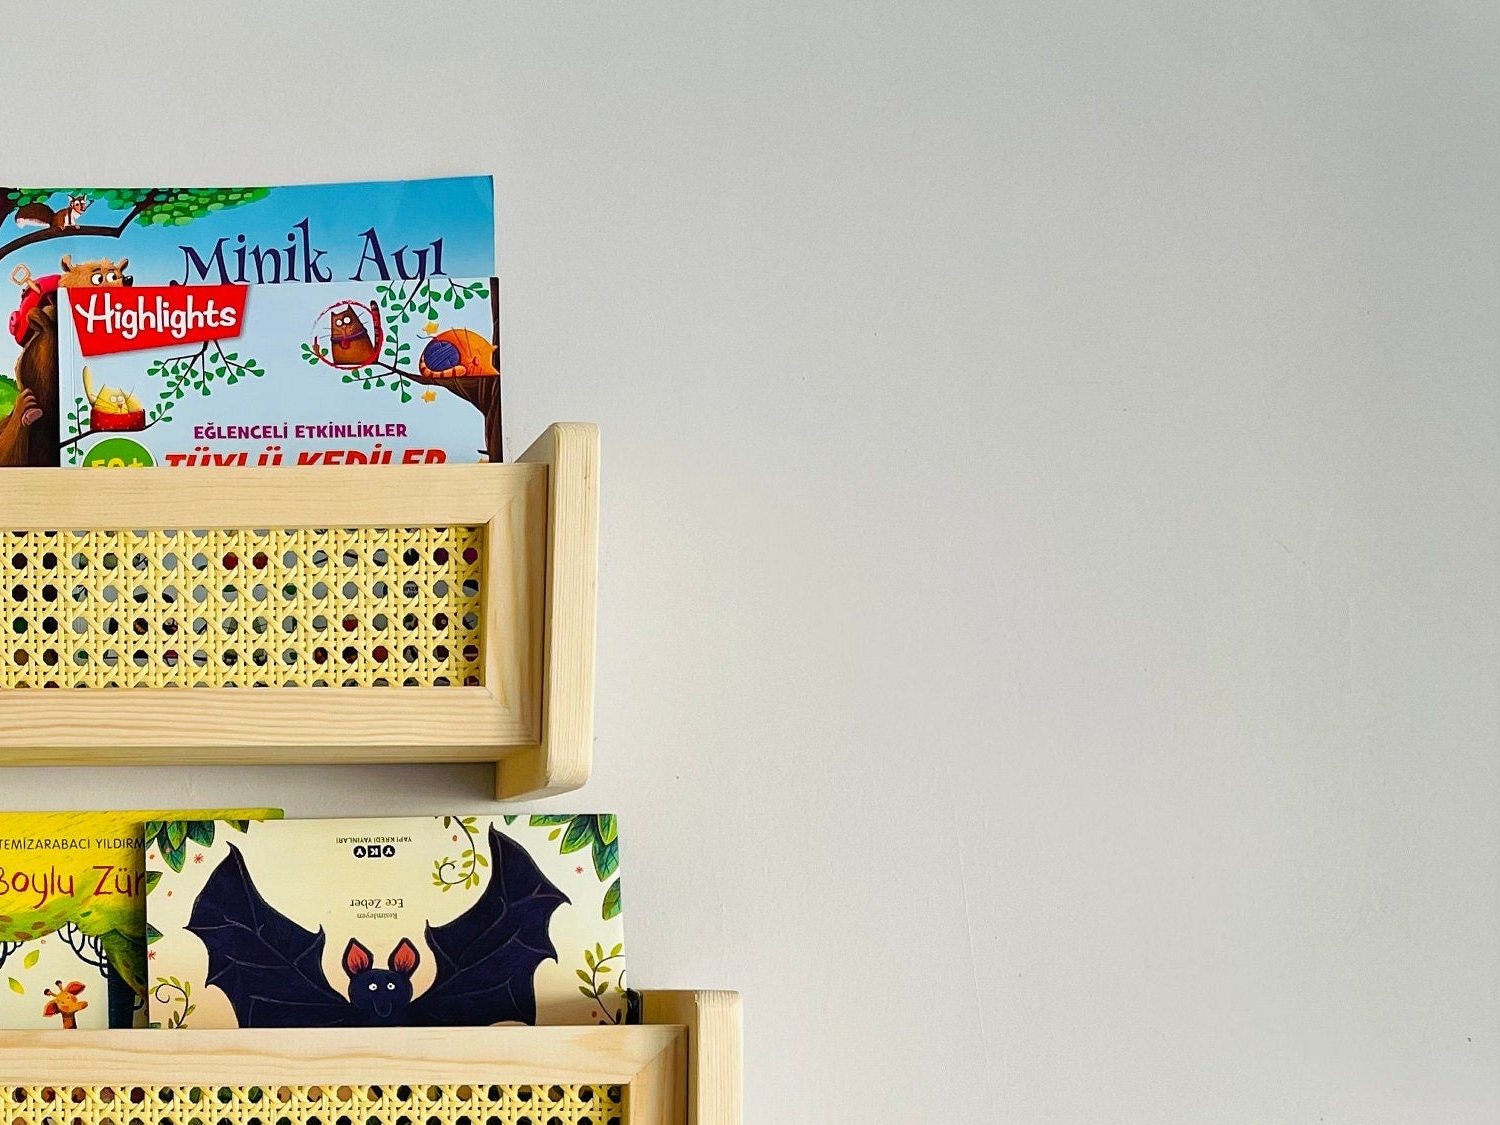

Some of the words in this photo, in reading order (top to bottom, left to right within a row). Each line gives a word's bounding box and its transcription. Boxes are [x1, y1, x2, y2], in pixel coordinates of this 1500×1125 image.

[170, 216, 333, 286] Minik
[75, 293, 237, 340] Highlights
[193, 422, 288, 440] EĞLENCELİ
[294, 420, 408, 439] ETKİNLİKLER
[349, 898, 381, 909] Zeber
[385, 898, 404, 908] Ece
